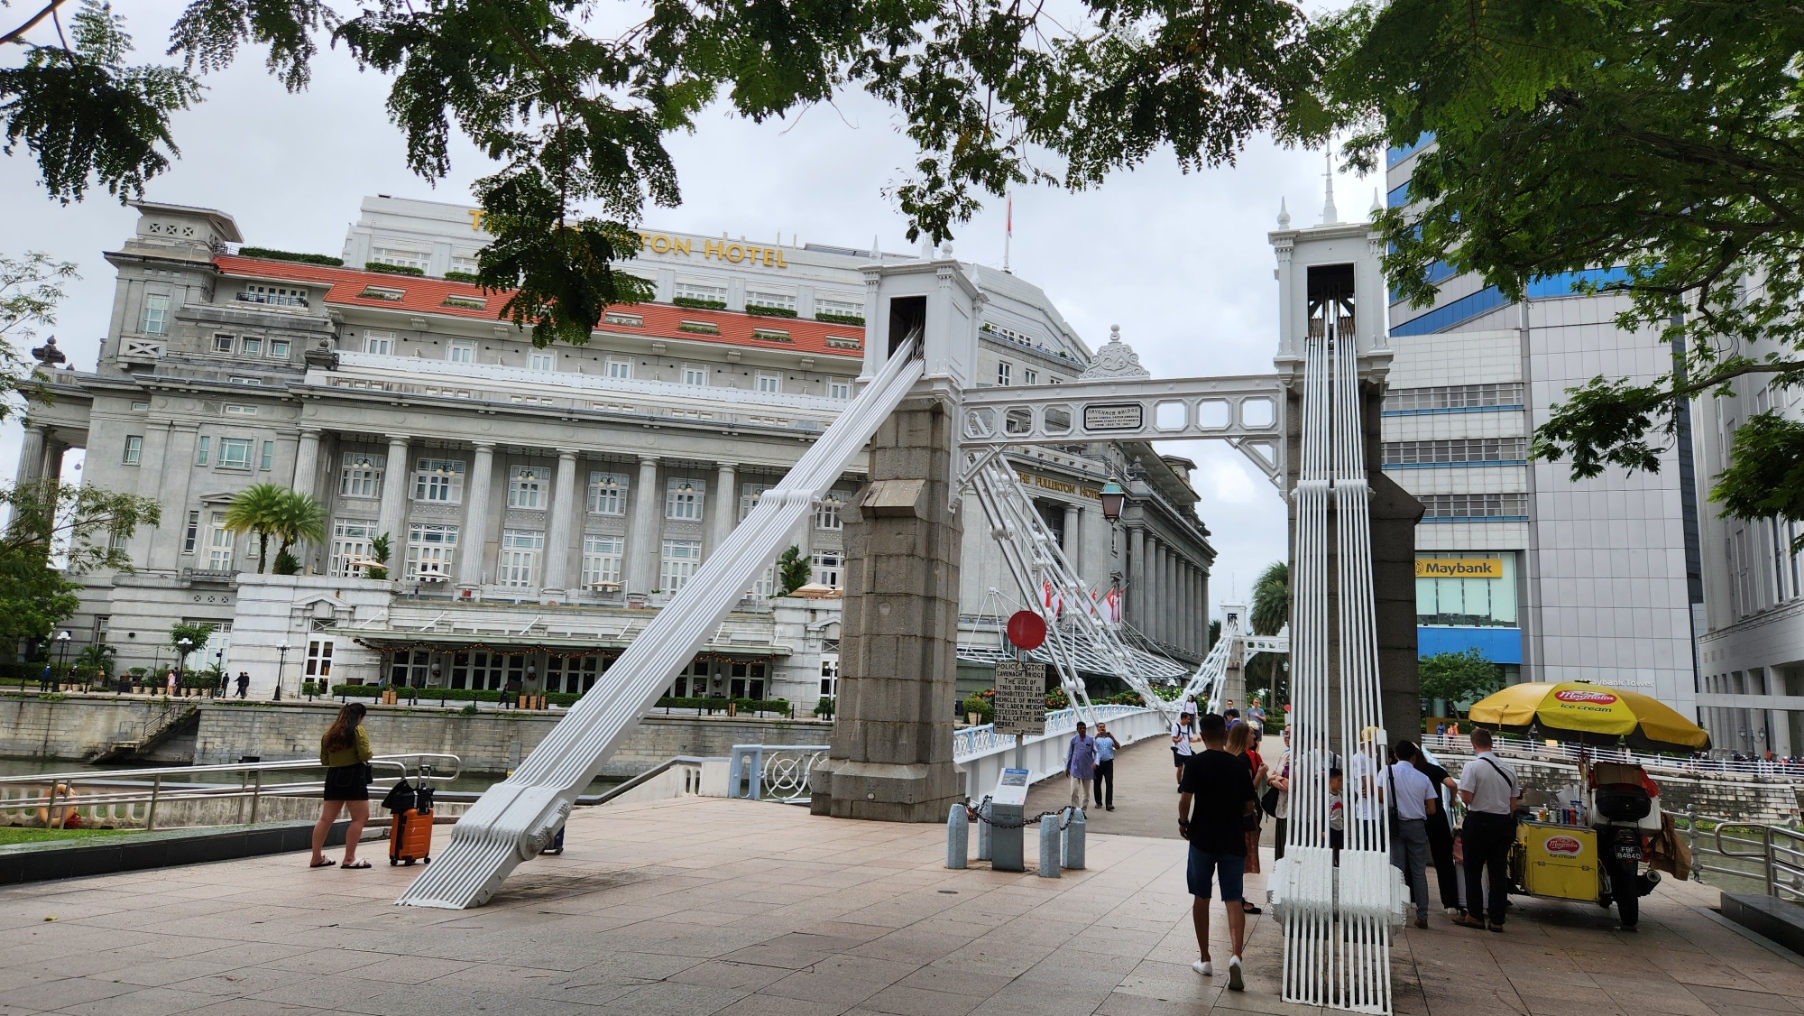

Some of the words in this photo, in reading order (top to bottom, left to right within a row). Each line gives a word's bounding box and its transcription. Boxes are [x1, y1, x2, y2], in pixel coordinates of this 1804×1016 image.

[704, 239, 788, 268] HOTEL
[1035, 475, 1076, 494] FULLERTON
[1080, 486, 1102, 500] HOTEL
[1426, 563, 1492, 575] Maybank
[996, 663, 1019, 671] POLICE
[1558, 691, 1615, 701] Magnolia
[1577, 705, 1612, 713] cream
